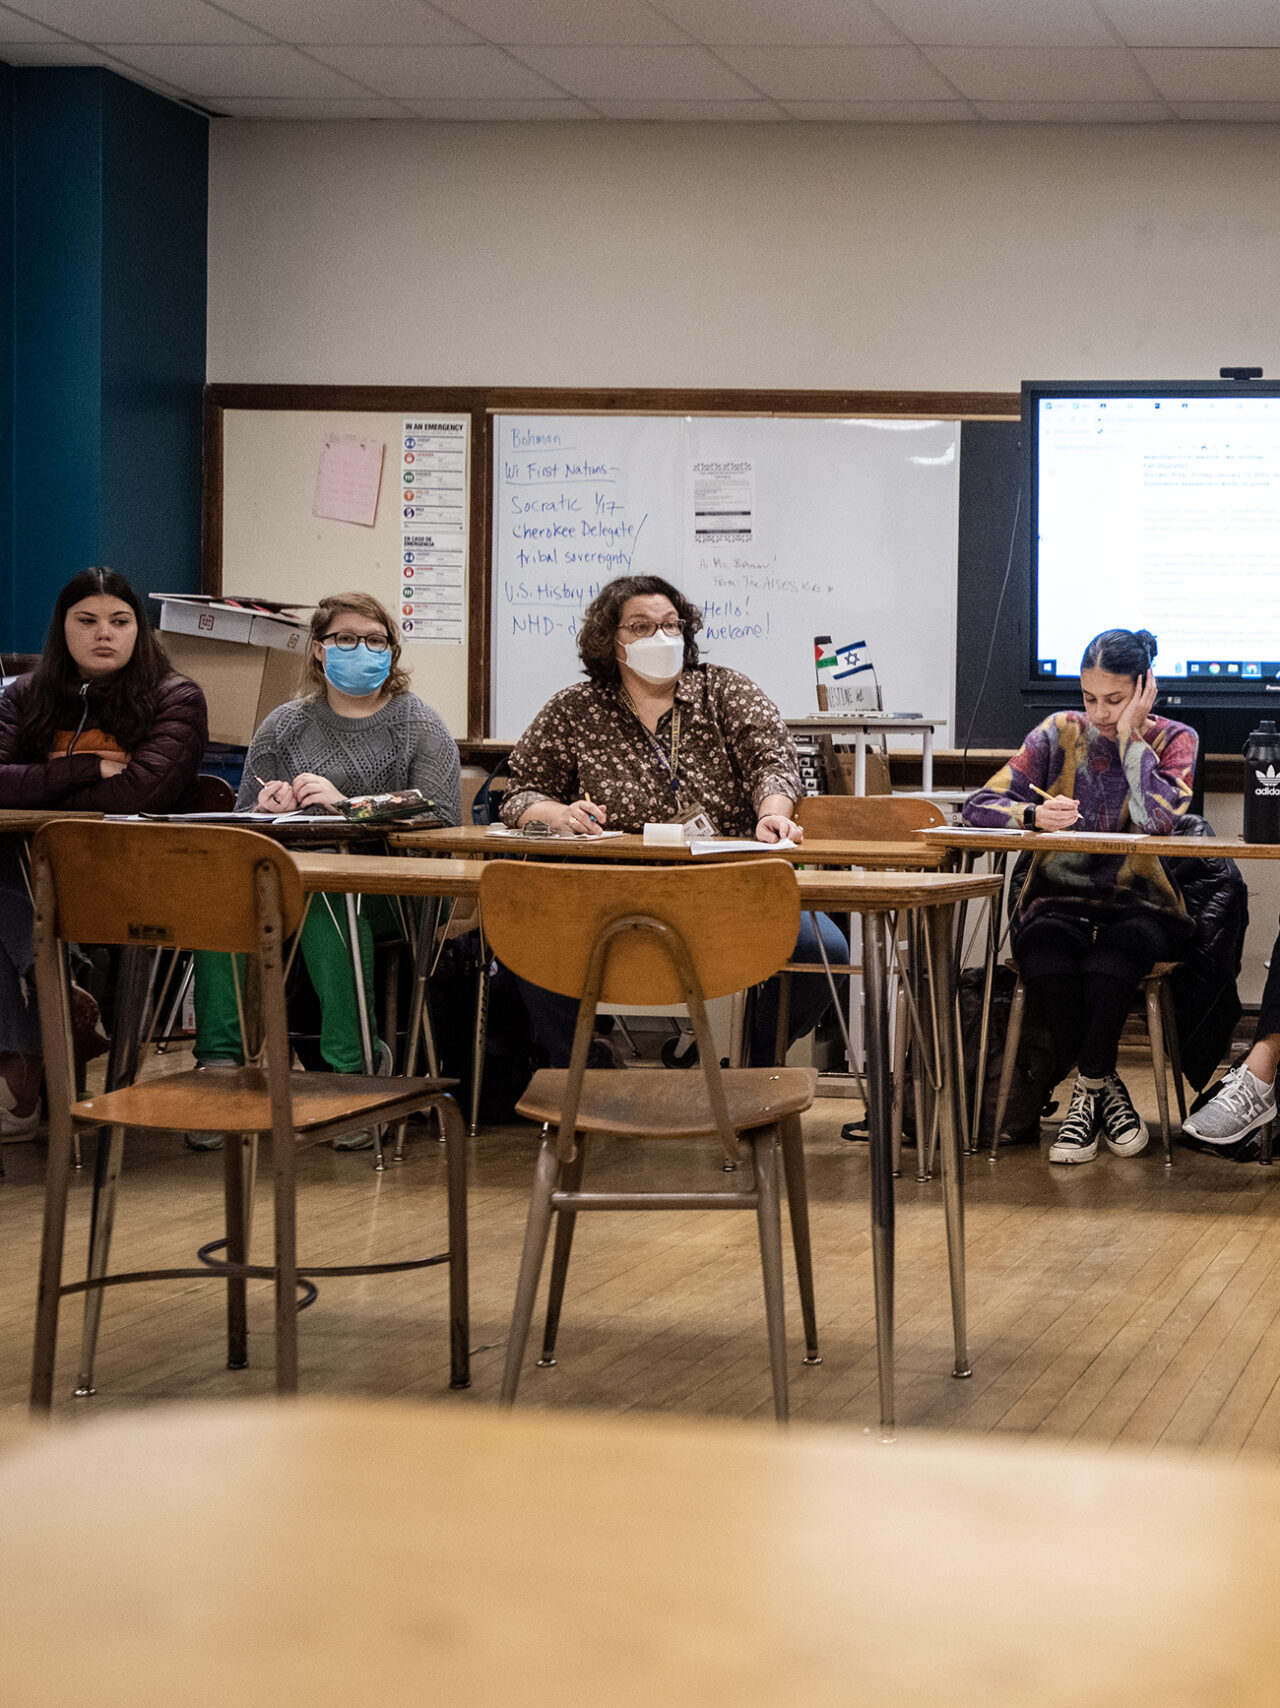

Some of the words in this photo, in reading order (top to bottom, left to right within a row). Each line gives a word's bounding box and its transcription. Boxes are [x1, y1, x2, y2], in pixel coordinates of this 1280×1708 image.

[527, 460, 559, 481] First
[511, 494, 582, 514] Socratic
[512, 522, 576, 539] Cherokee
[516, 548, 558, 569] tribal
[564, 550, 632, 572] sovereignty
[537, 582, 584, 608] History
[703, 595, 750, 618] Hello!
